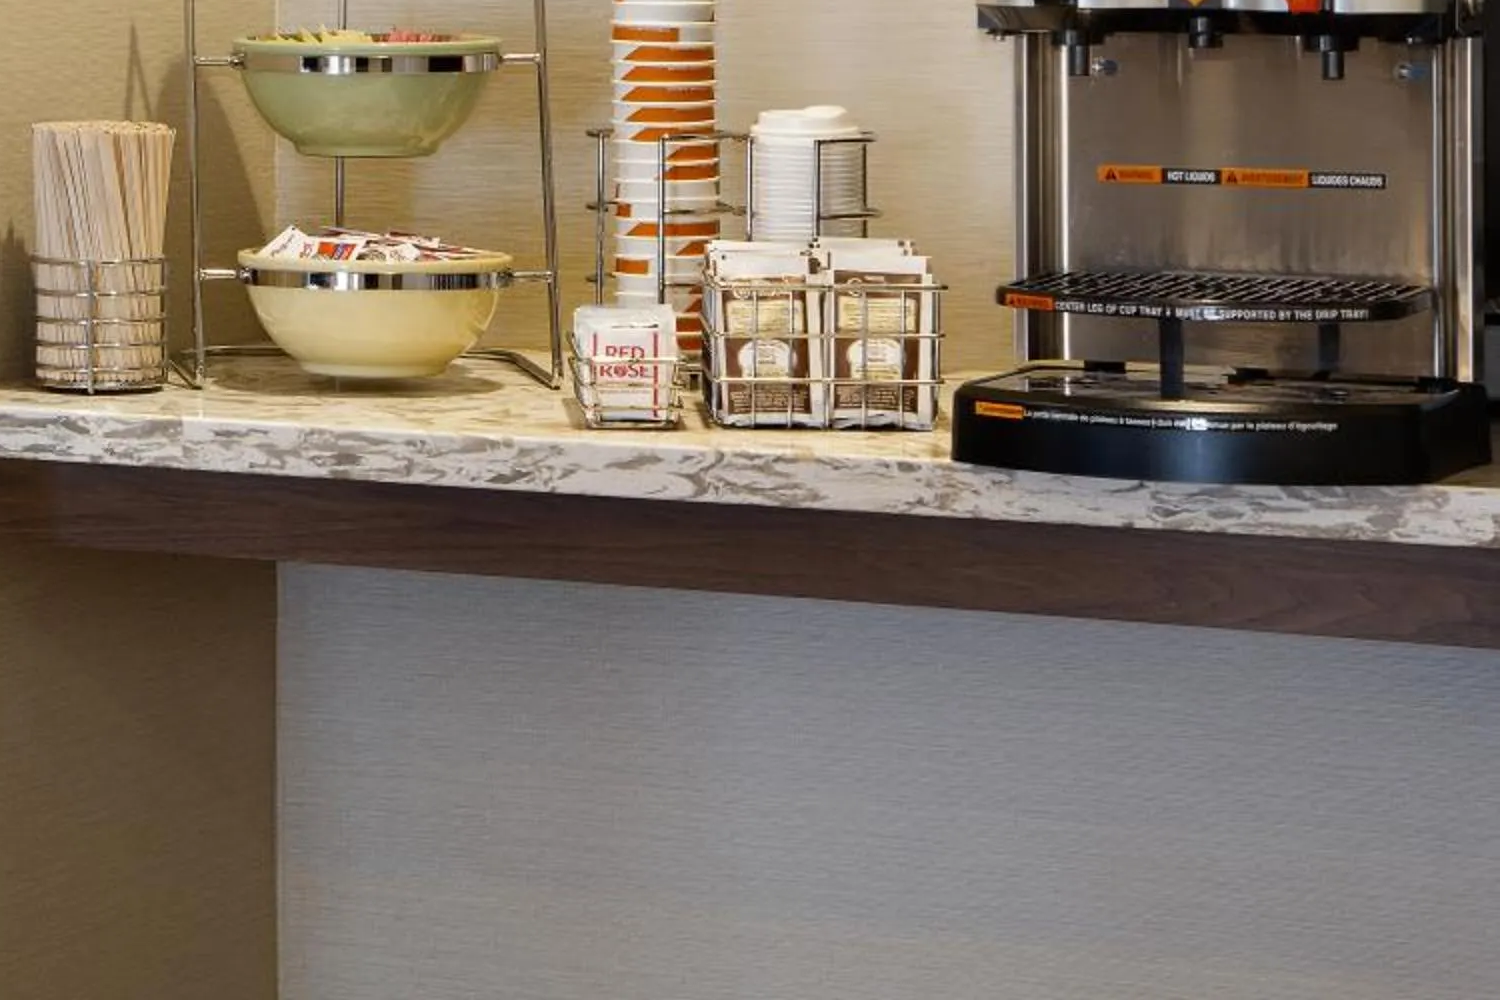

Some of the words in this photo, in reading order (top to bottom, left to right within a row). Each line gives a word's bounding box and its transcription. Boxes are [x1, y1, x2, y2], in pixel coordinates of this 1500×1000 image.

[1119, 305, 1137, 315] CUP
[1219, 308, 1276, 320] SUPPORTED
[1278, 309, 1292, 320] BY
[1293, 309, 1313, 320] THE
[605, 345, 645, 359] RED
